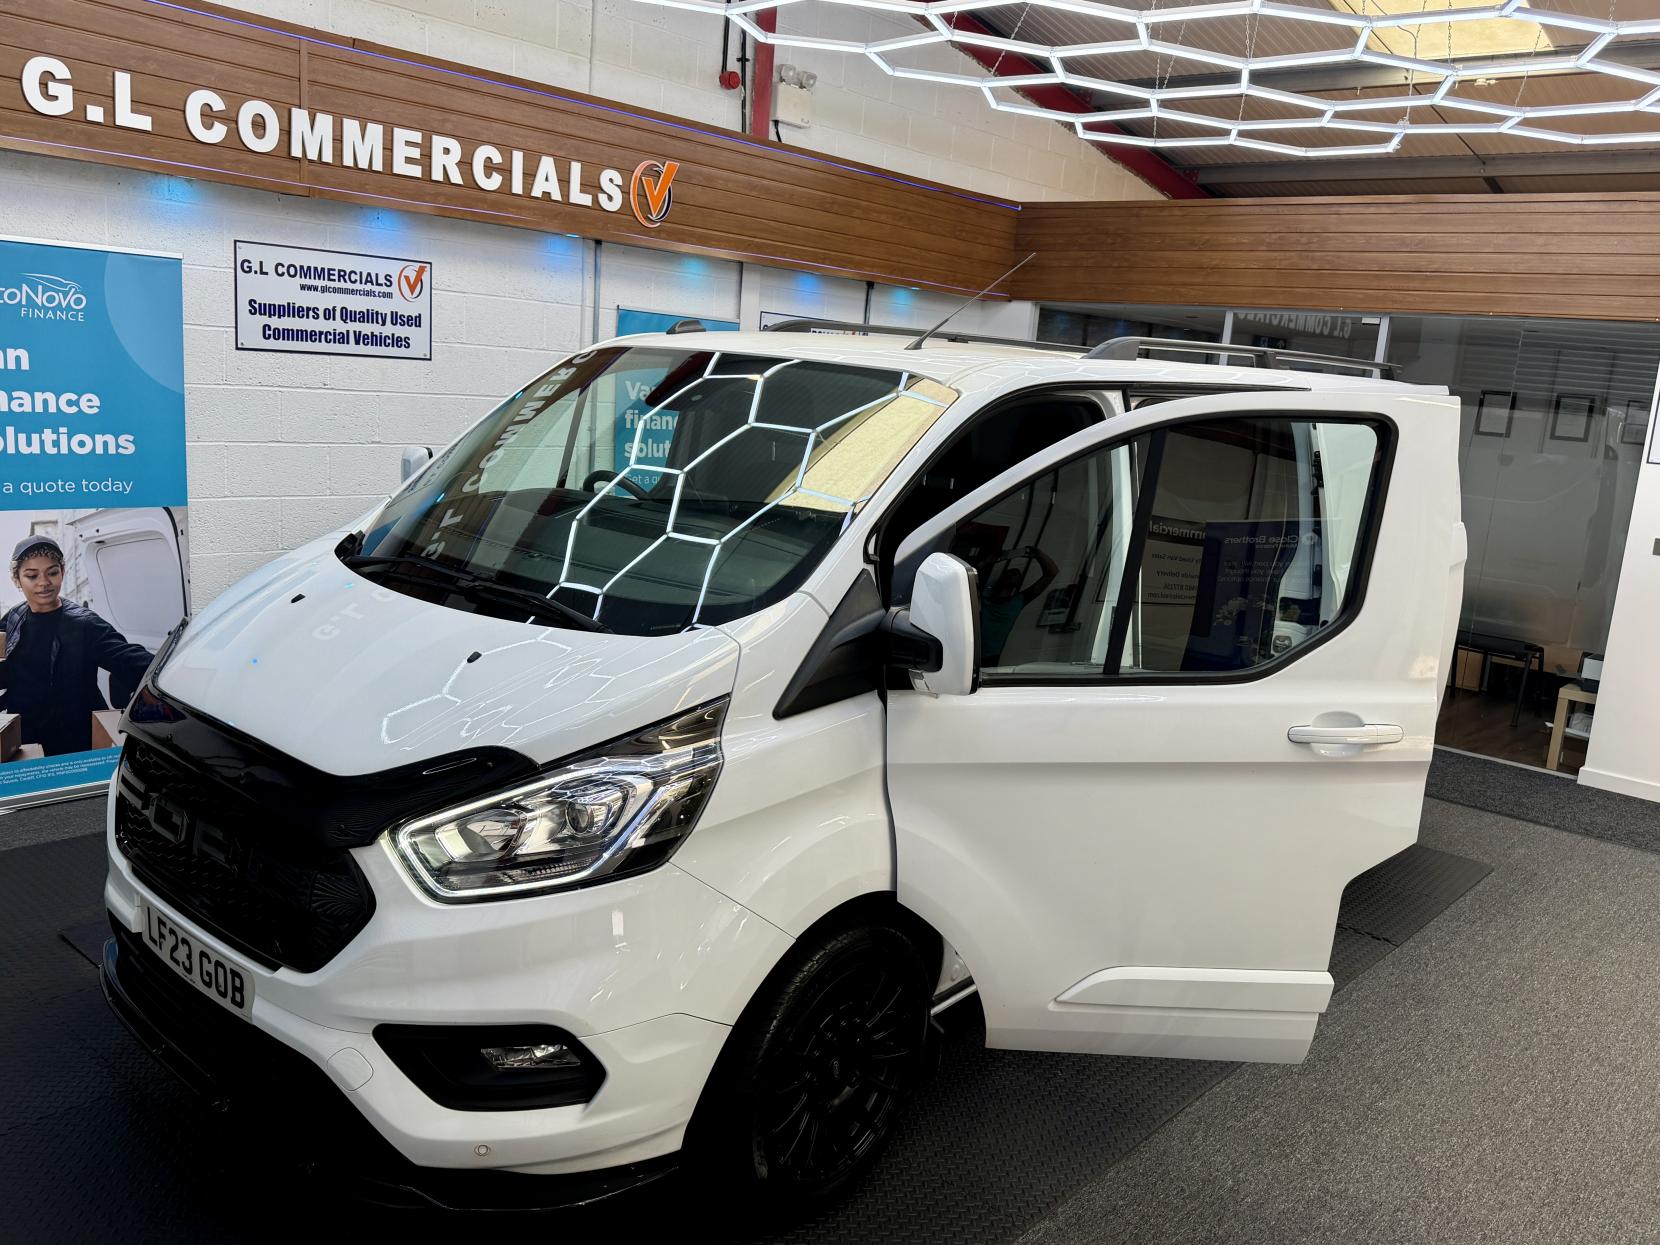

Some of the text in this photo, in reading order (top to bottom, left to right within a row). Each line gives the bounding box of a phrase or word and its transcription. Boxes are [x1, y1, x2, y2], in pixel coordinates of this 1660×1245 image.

[21, 56, 622, 212] G.L COMMERCIALS
[240, 259, 393, 288] G.L COMMERCIALS
[299, 283, 393, 299] www.glcommercials.com
[21, 307, 86, 322] FINANCE
[248, 299, 422, 328] Suppliers of Quality Used
[262, 323, 411, 349] Commercial Vehicles
[0, 347, 30, 370] n
[625, 380, 655, 400] Va
[0, 426, 136, 455] lutions
[2, 477, 133, 496] a quote today
[146, 904, 245, 1009] LF23 GOB
